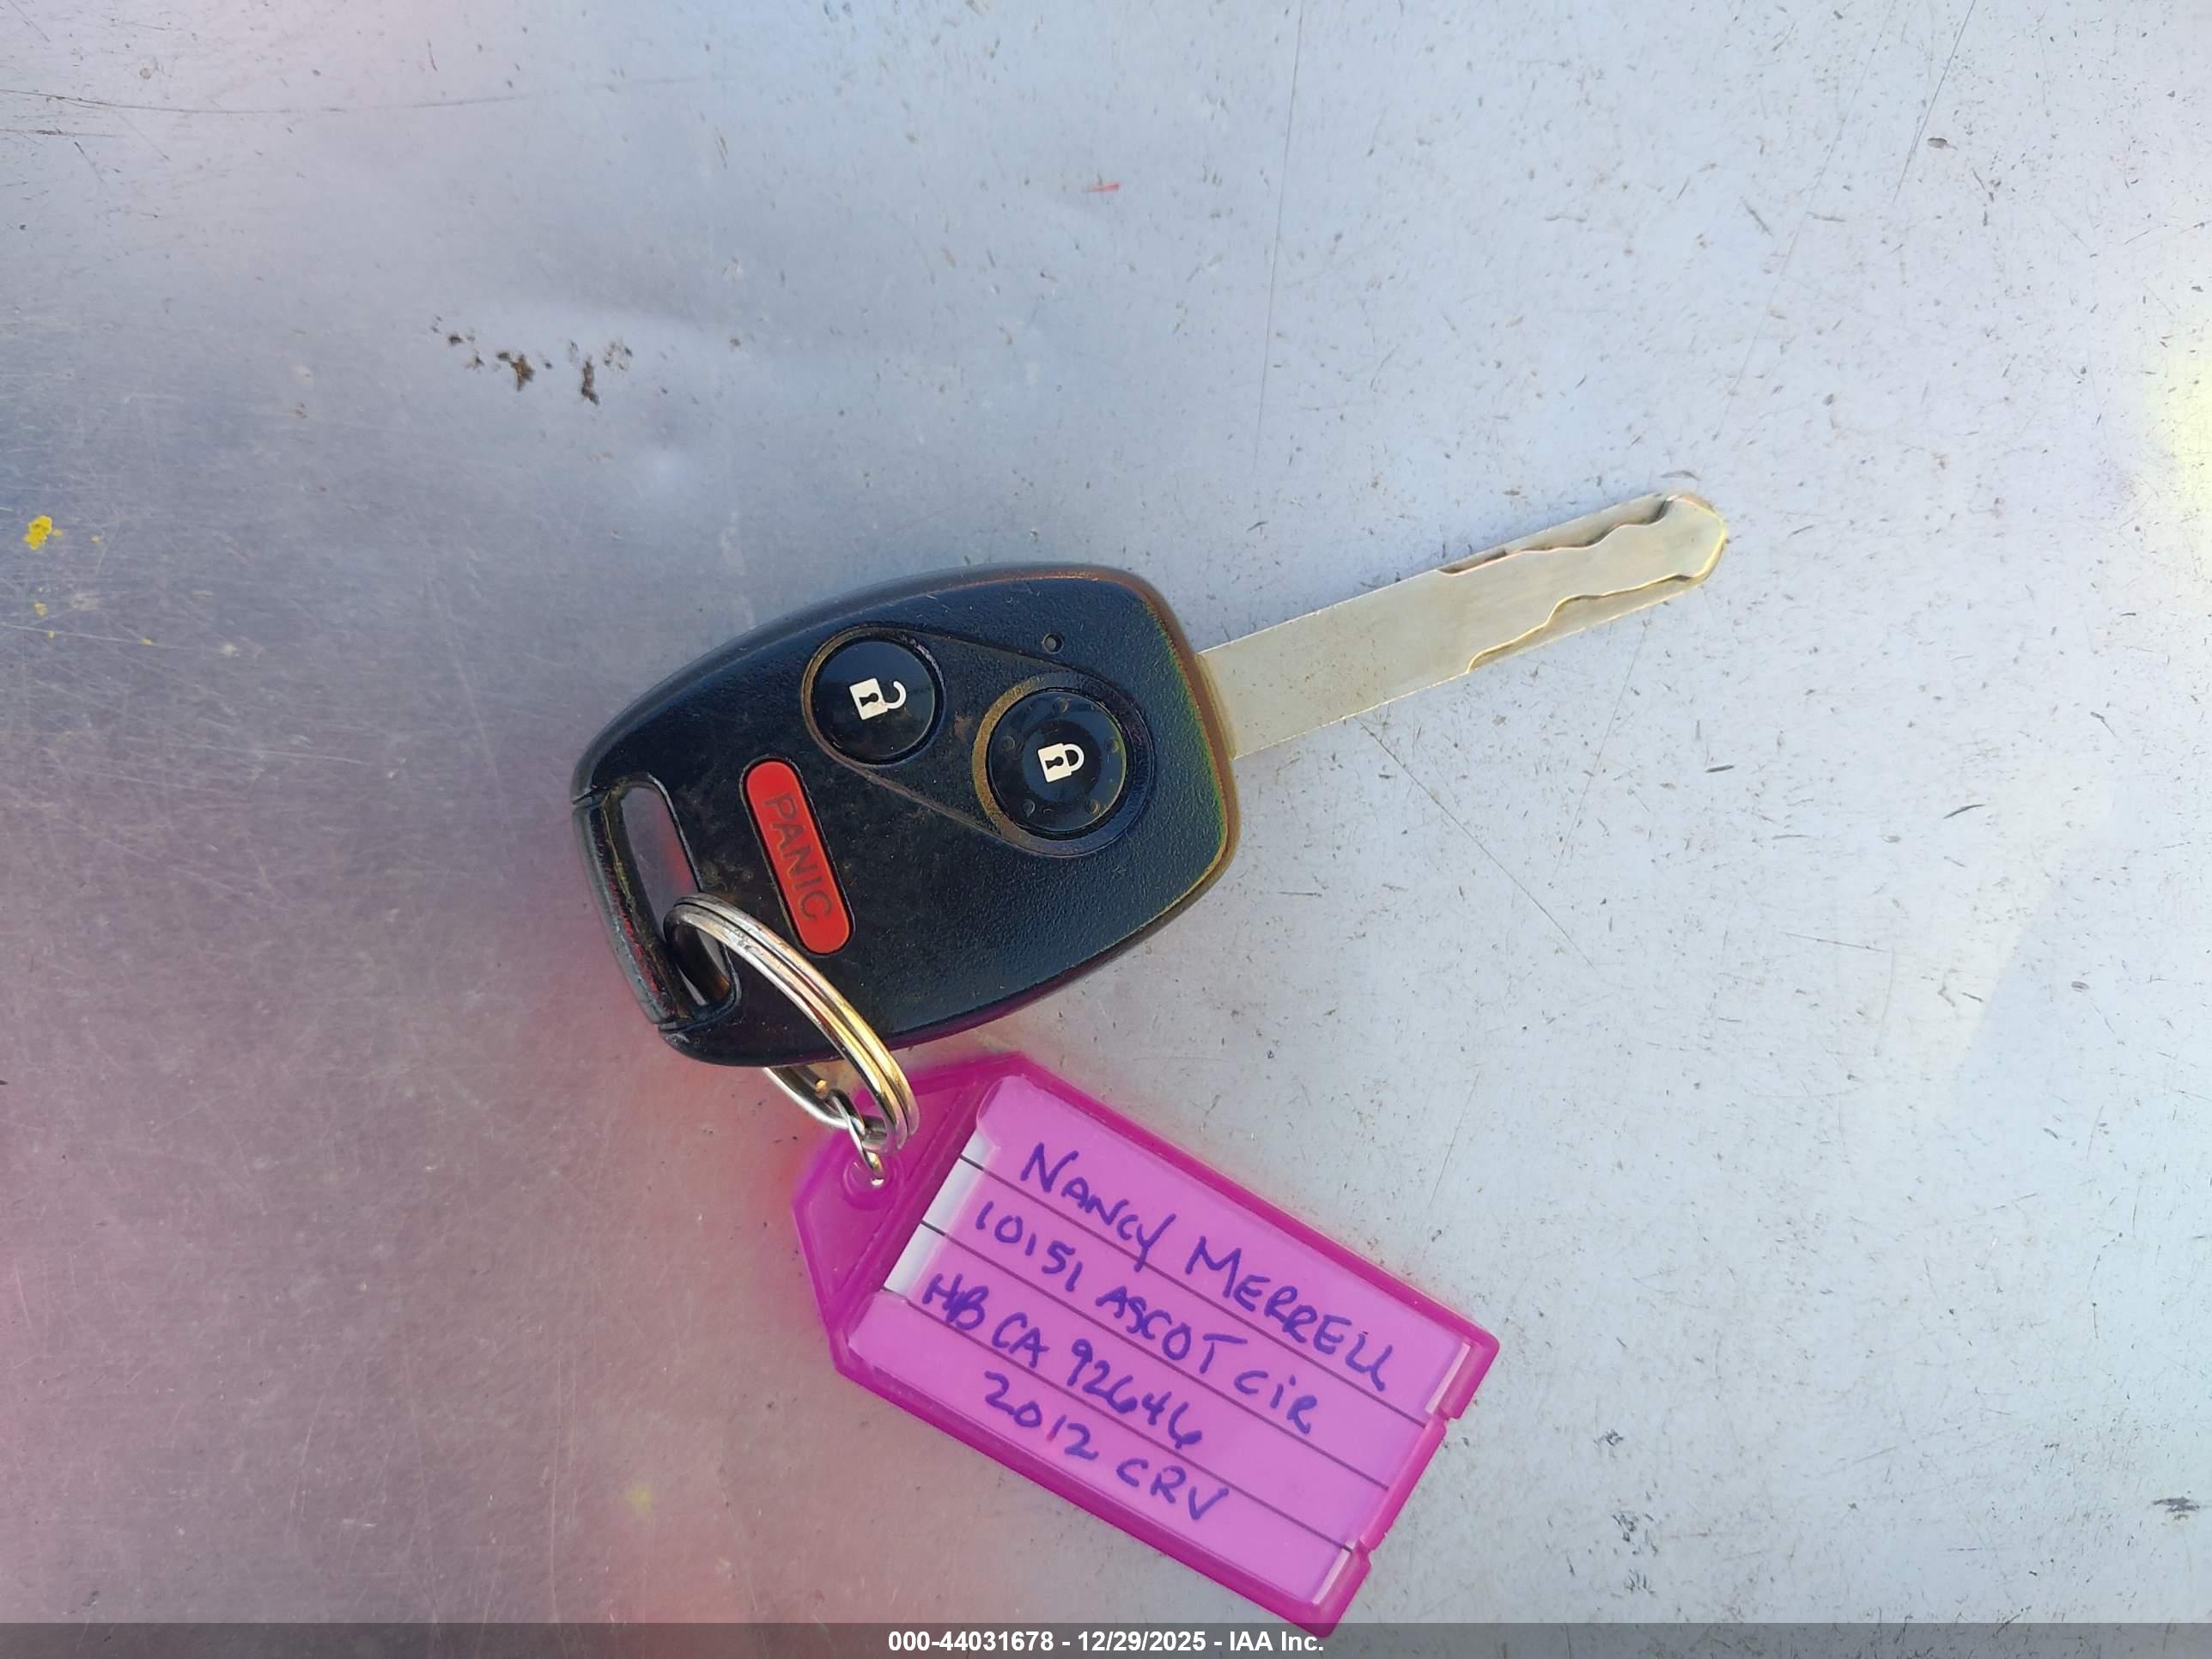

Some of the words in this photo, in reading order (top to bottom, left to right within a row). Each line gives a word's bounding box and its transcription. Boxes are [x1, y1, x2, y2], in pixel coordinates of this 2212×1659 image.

[765, 793, 831, 921] PANIC
[975, 1202, 1083, 1291] 10151
[1097, 1286, 1248, 1373] ASCOT
[984, 1371, 1099, 1462] 2012
[1116, 1456, 1229, 1521] CRV
[992, 1314, 1049, 1367] CA
[1066, 1338, 1203, 1449] 92646
